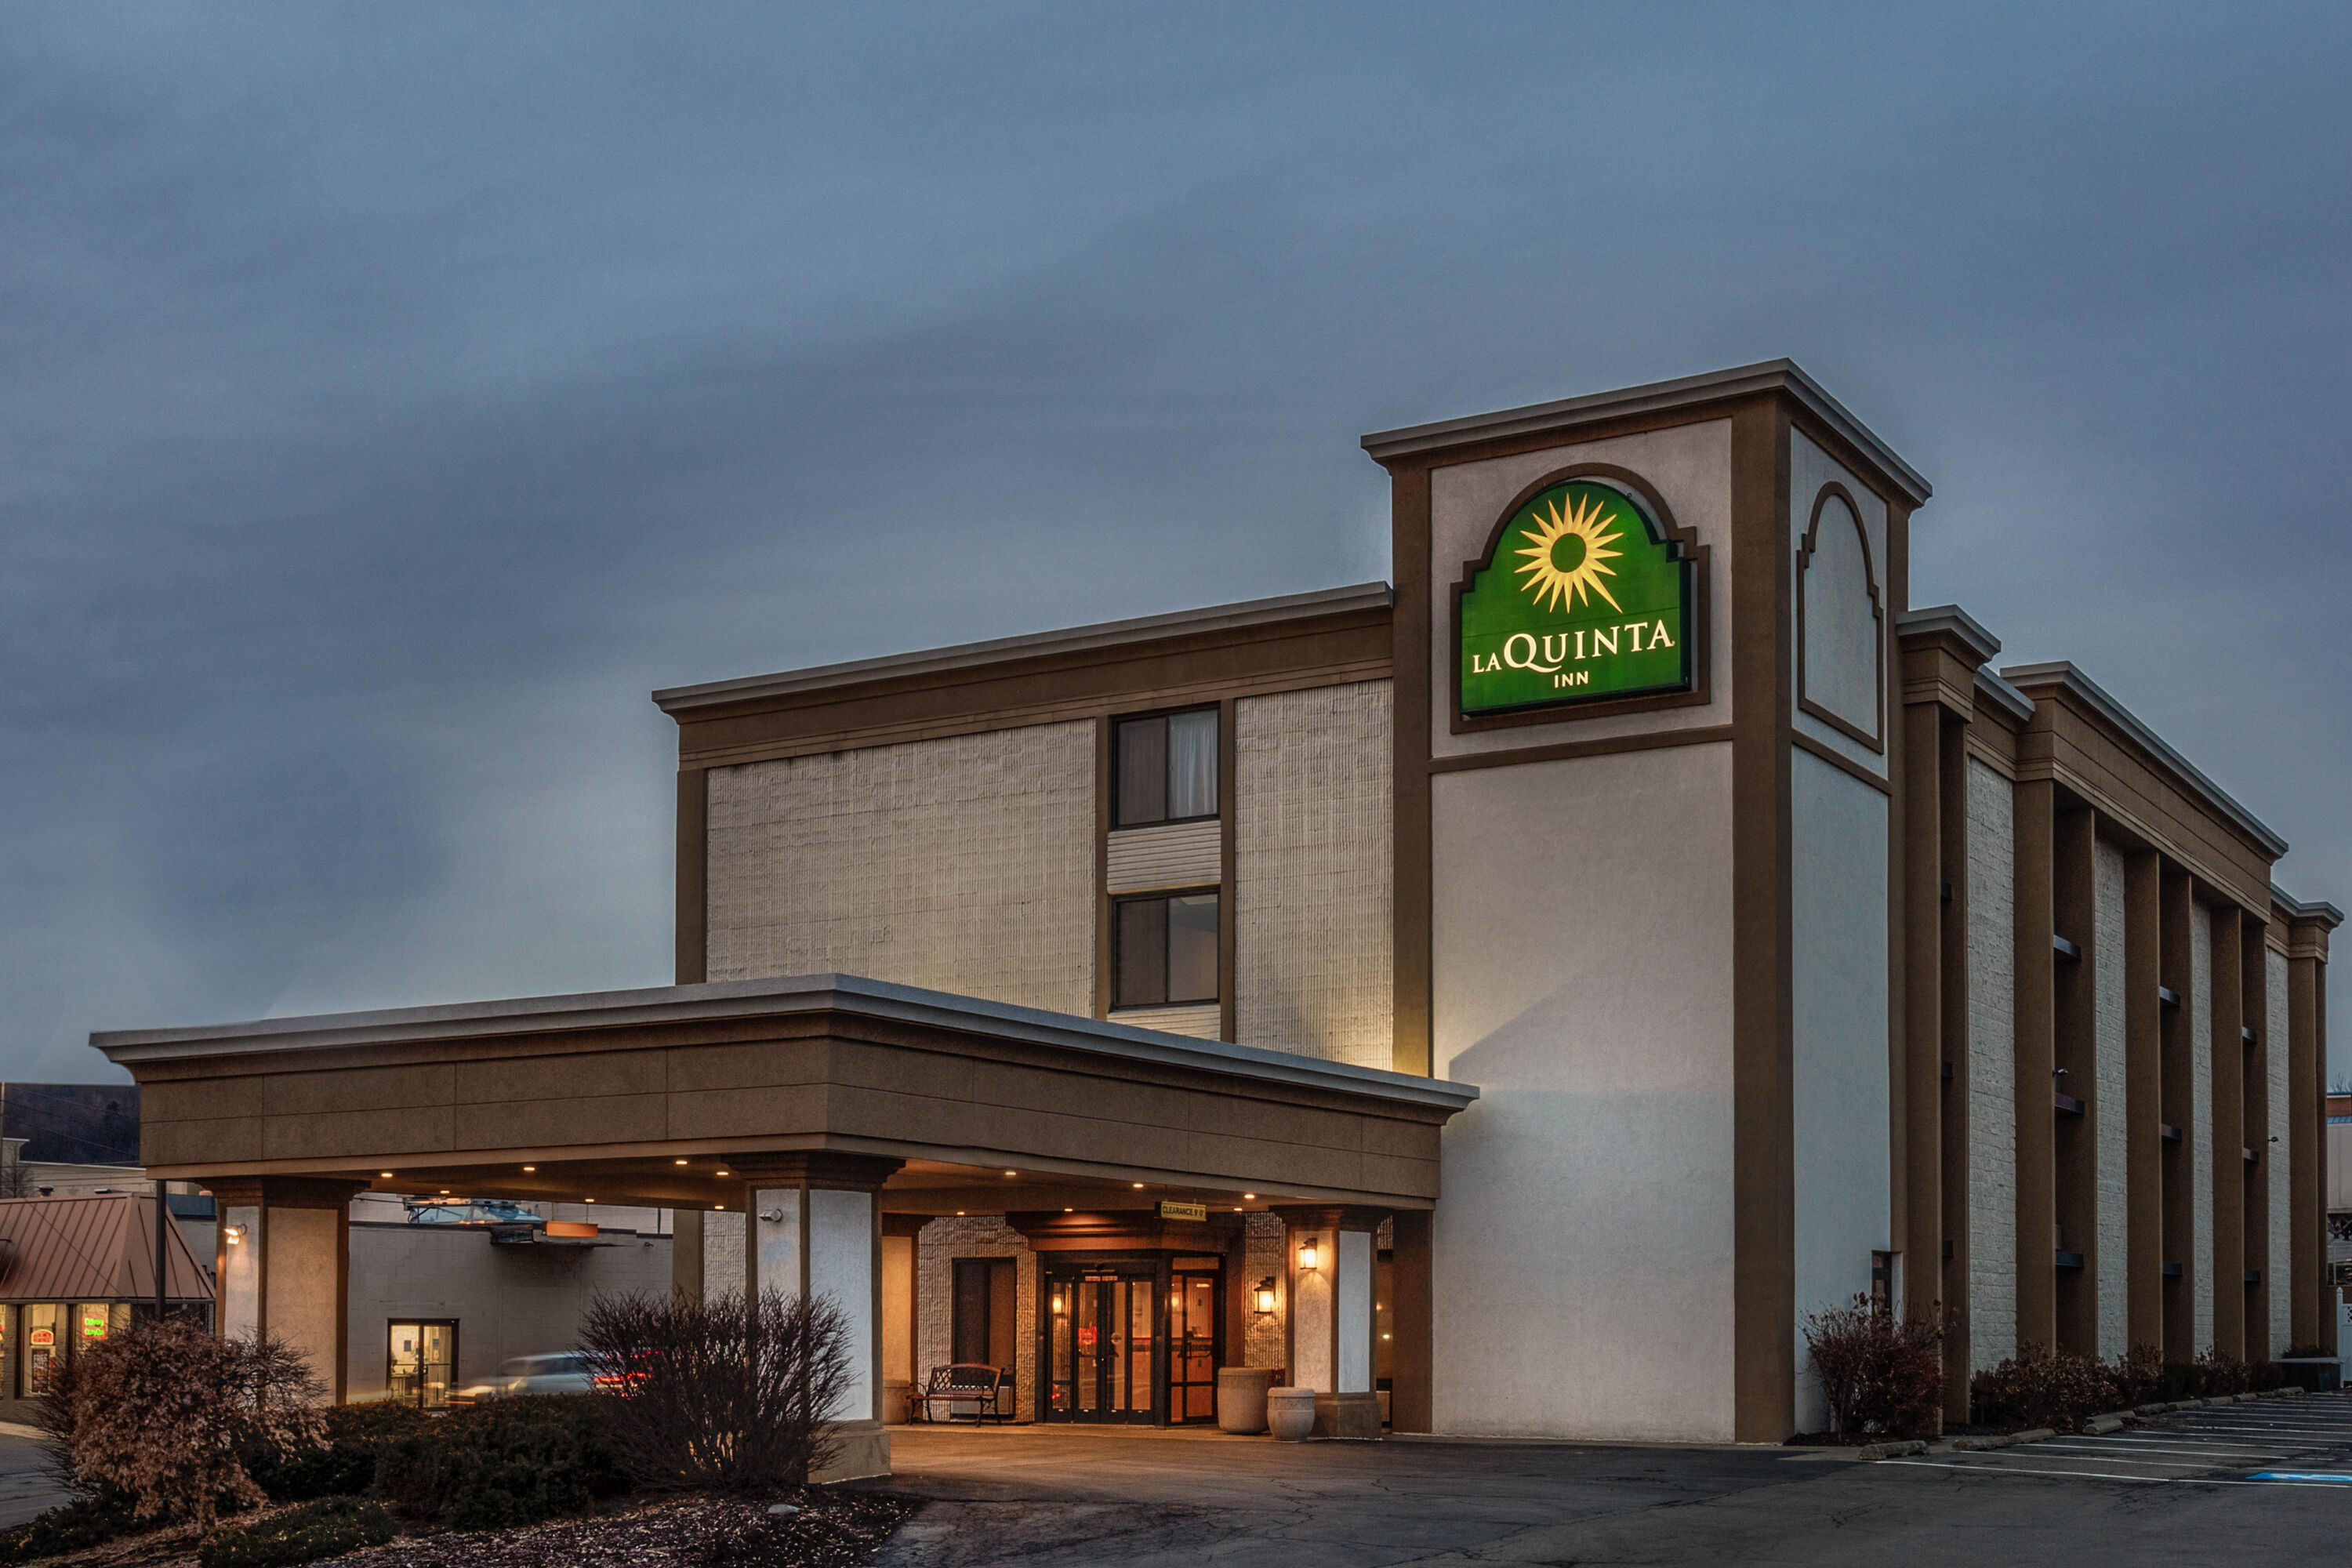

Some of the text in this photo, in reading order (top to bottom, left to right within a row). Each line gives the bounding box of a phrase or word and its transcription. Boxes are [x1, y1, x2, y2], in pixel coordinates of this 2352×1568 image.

[1472, 619, 1675, 673] LA QUINTA
[1554, 671, 1589, 689] INN
[1163, 1206, 1192, 1216] CLEARANCE
